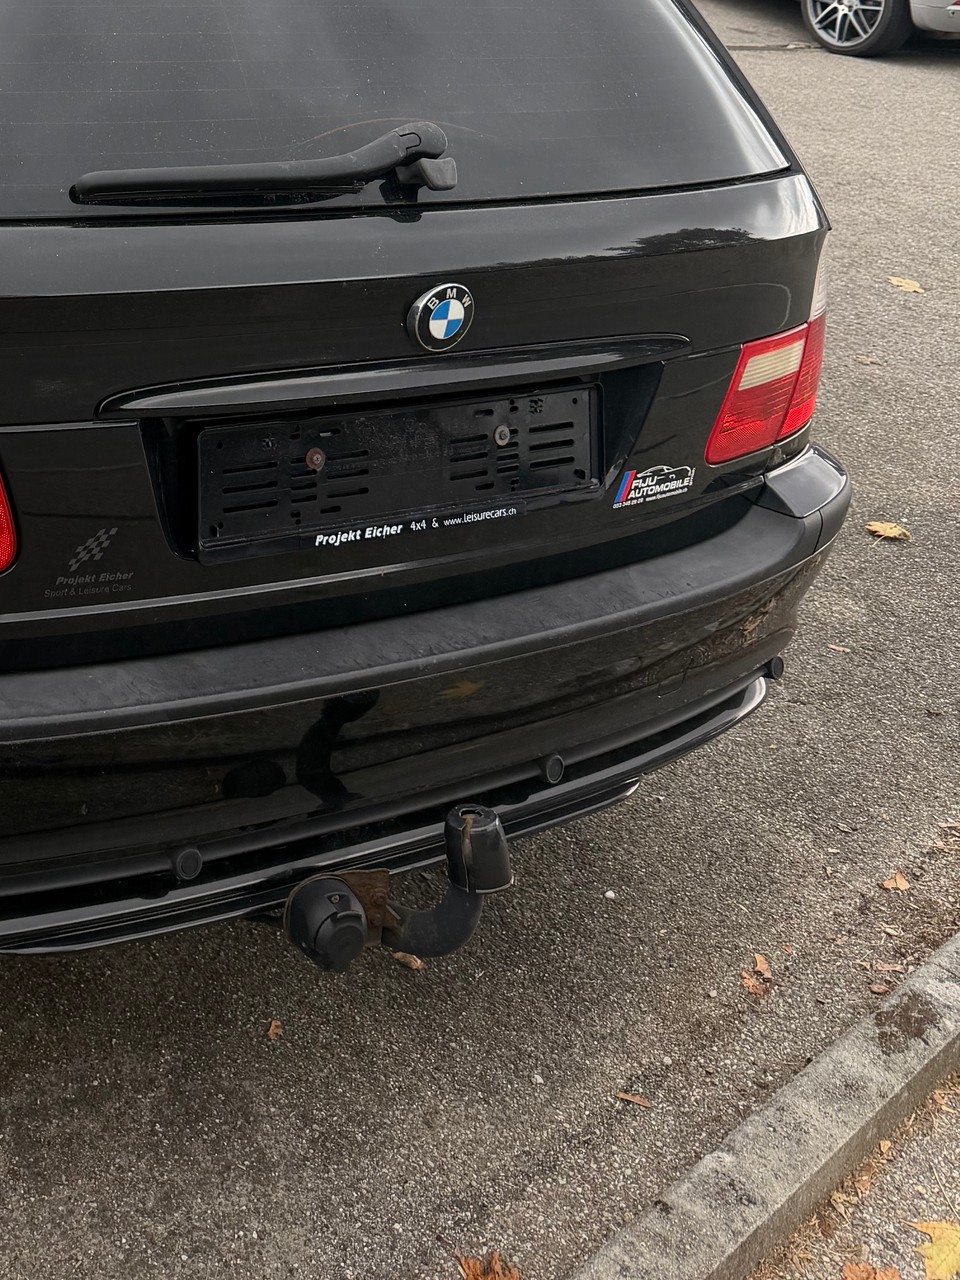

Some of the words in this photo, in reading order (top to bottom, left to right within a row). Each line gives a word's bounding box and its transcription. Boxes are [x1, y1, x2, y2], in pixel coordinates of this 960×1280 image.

[426, 288, 472, 310] BMW
[627, 477, 690, 499] AUTOMOBILE
[631, 477, 657, 489] FIJU
[315, 530, 361, 546] Projekt
[365, 524, 403, 539] Eicher
[410, 521, 427, 531] 4x4
[431, 518, 439, 528] &
[56, 574, 96, 585] Projekt
[99, 572, 134, 582] Eicher
[44, 589, 68, 598] Sport
[69, 588, 76, 596] &
[78, 585, 110, 595] Leisure
[112, 583, 132, 592] Cars
